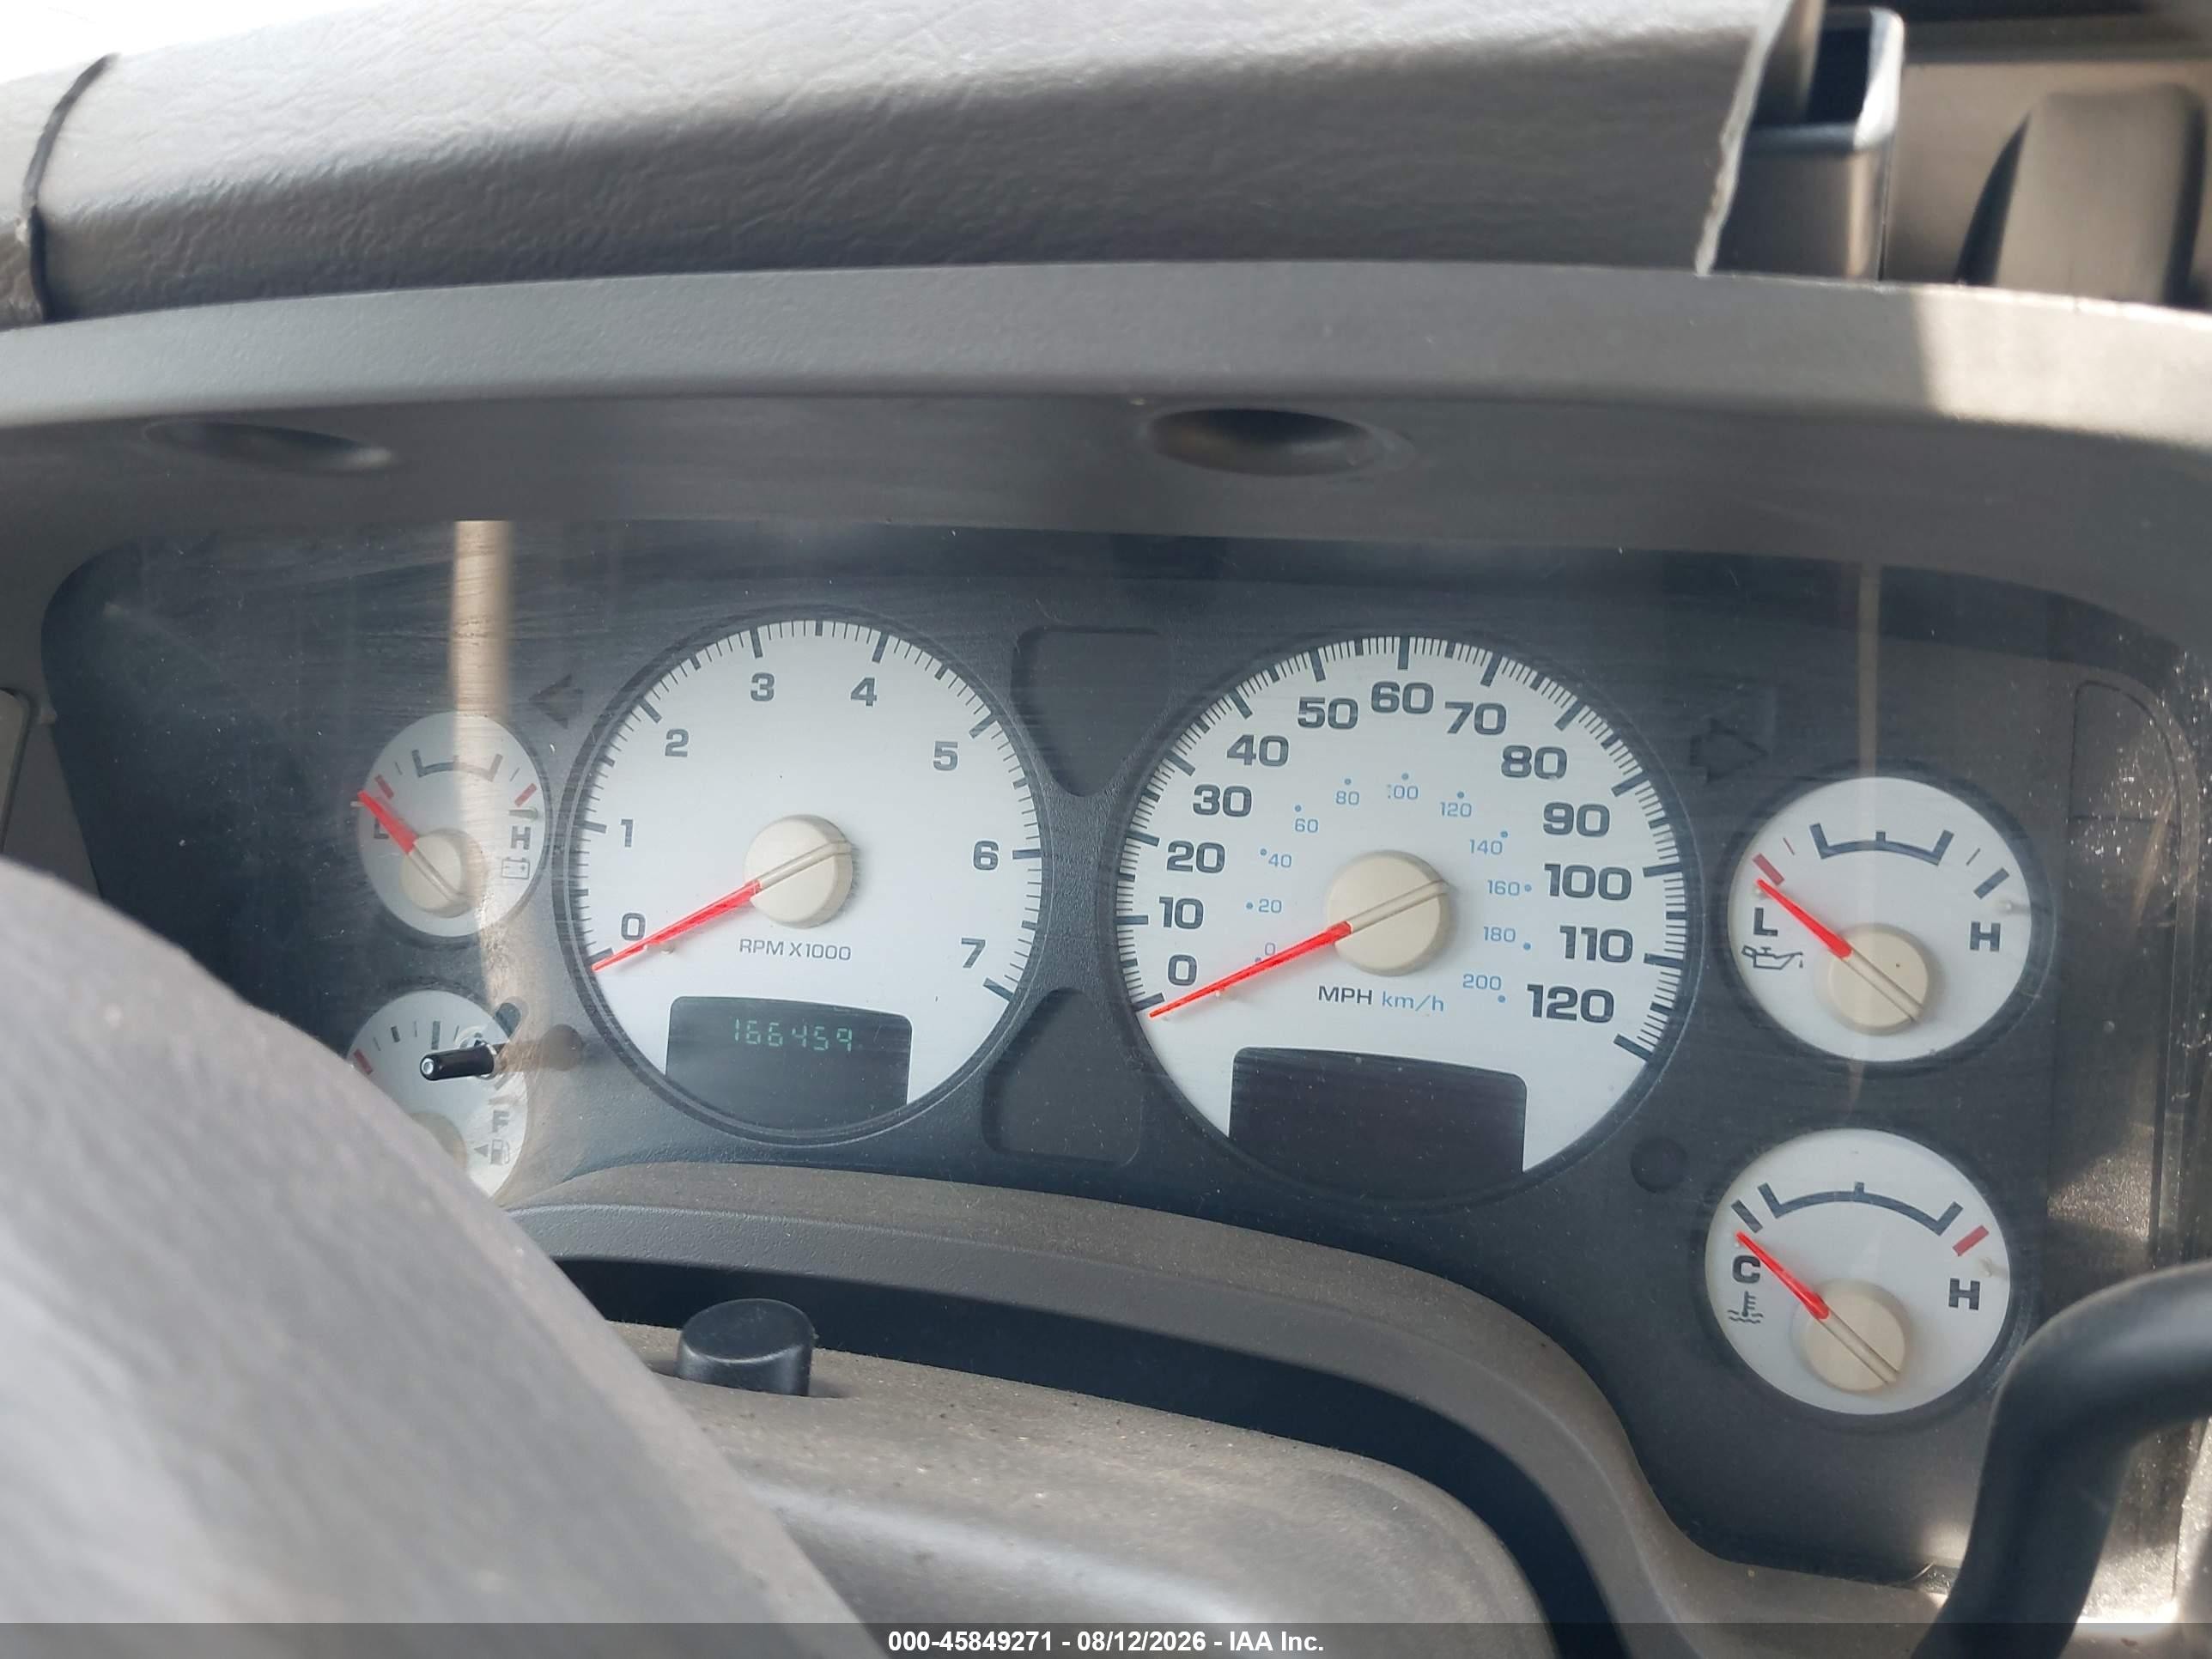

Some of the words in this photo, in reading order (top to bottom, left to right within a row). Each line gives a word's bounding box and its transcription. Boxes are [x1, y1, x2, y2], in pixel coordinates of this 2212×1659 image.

[750, 672, 775, 702] 3
[851, 678, 878, 706] 4
[1370, 682, 1434, 714] 60
[1297, 697, 1358, 730] 50
[1444, 702, 1507, 735] 70
[665, 729, 689, 757] 2
[933, 741, 958, 771] 5
[1226, 735, 1290, 767] 40
[1501, 745, 1568, 779] 80
[1193, 785, 1252, 817] 30
[1335, 791, 1360, 805] 80
[1387, 785, 1419, 800] 00
[1440, 802, 1473, 817] 120
[1542, 804, 1609, 837] 90
[510, 826, 531, 848] H
[621, 819, 633, 847] 1
[1294, 818, 1318, 833] 60
[973, 841, 999, 870] 6
[1166, 842, 1225, 873] 20
[1267, 854, 1291, 867] 40
[1469, 839, 1503, 854] 140
[1488, 881, 1520, 896] 160
[1543, 864, 1632, 899] 100
[1158, 897, 1203, 929] 10
[1258, 898, 1282, 914] 20
[621, 913, 646, 941] 0
[1484, 927, 1516, 943] 180
[1754, 908, 1778, 937] L
[1970, 923, 2001, 951] H
[739, 939, 784, 956] RPM
[789, 941, 851, 961] X1000
[961, 938, 986, 969] 7
[1559, 926, 1633, 963] 110
[1168, 954, 1197, 987] 0
[1462, 975, 1502, 990] 200
[1318, 986, 1372, 1006] MPH
[1381, 992, 1444, 1012] km/h
[1527, 985, 1614, 1023] 120
[733, 1018, 853, 1051] 166459
[492, 1111, 509, 1133] F
[1733, 1255, 1760, 1284] C
[1948, 1278, 1979, 1310] H
